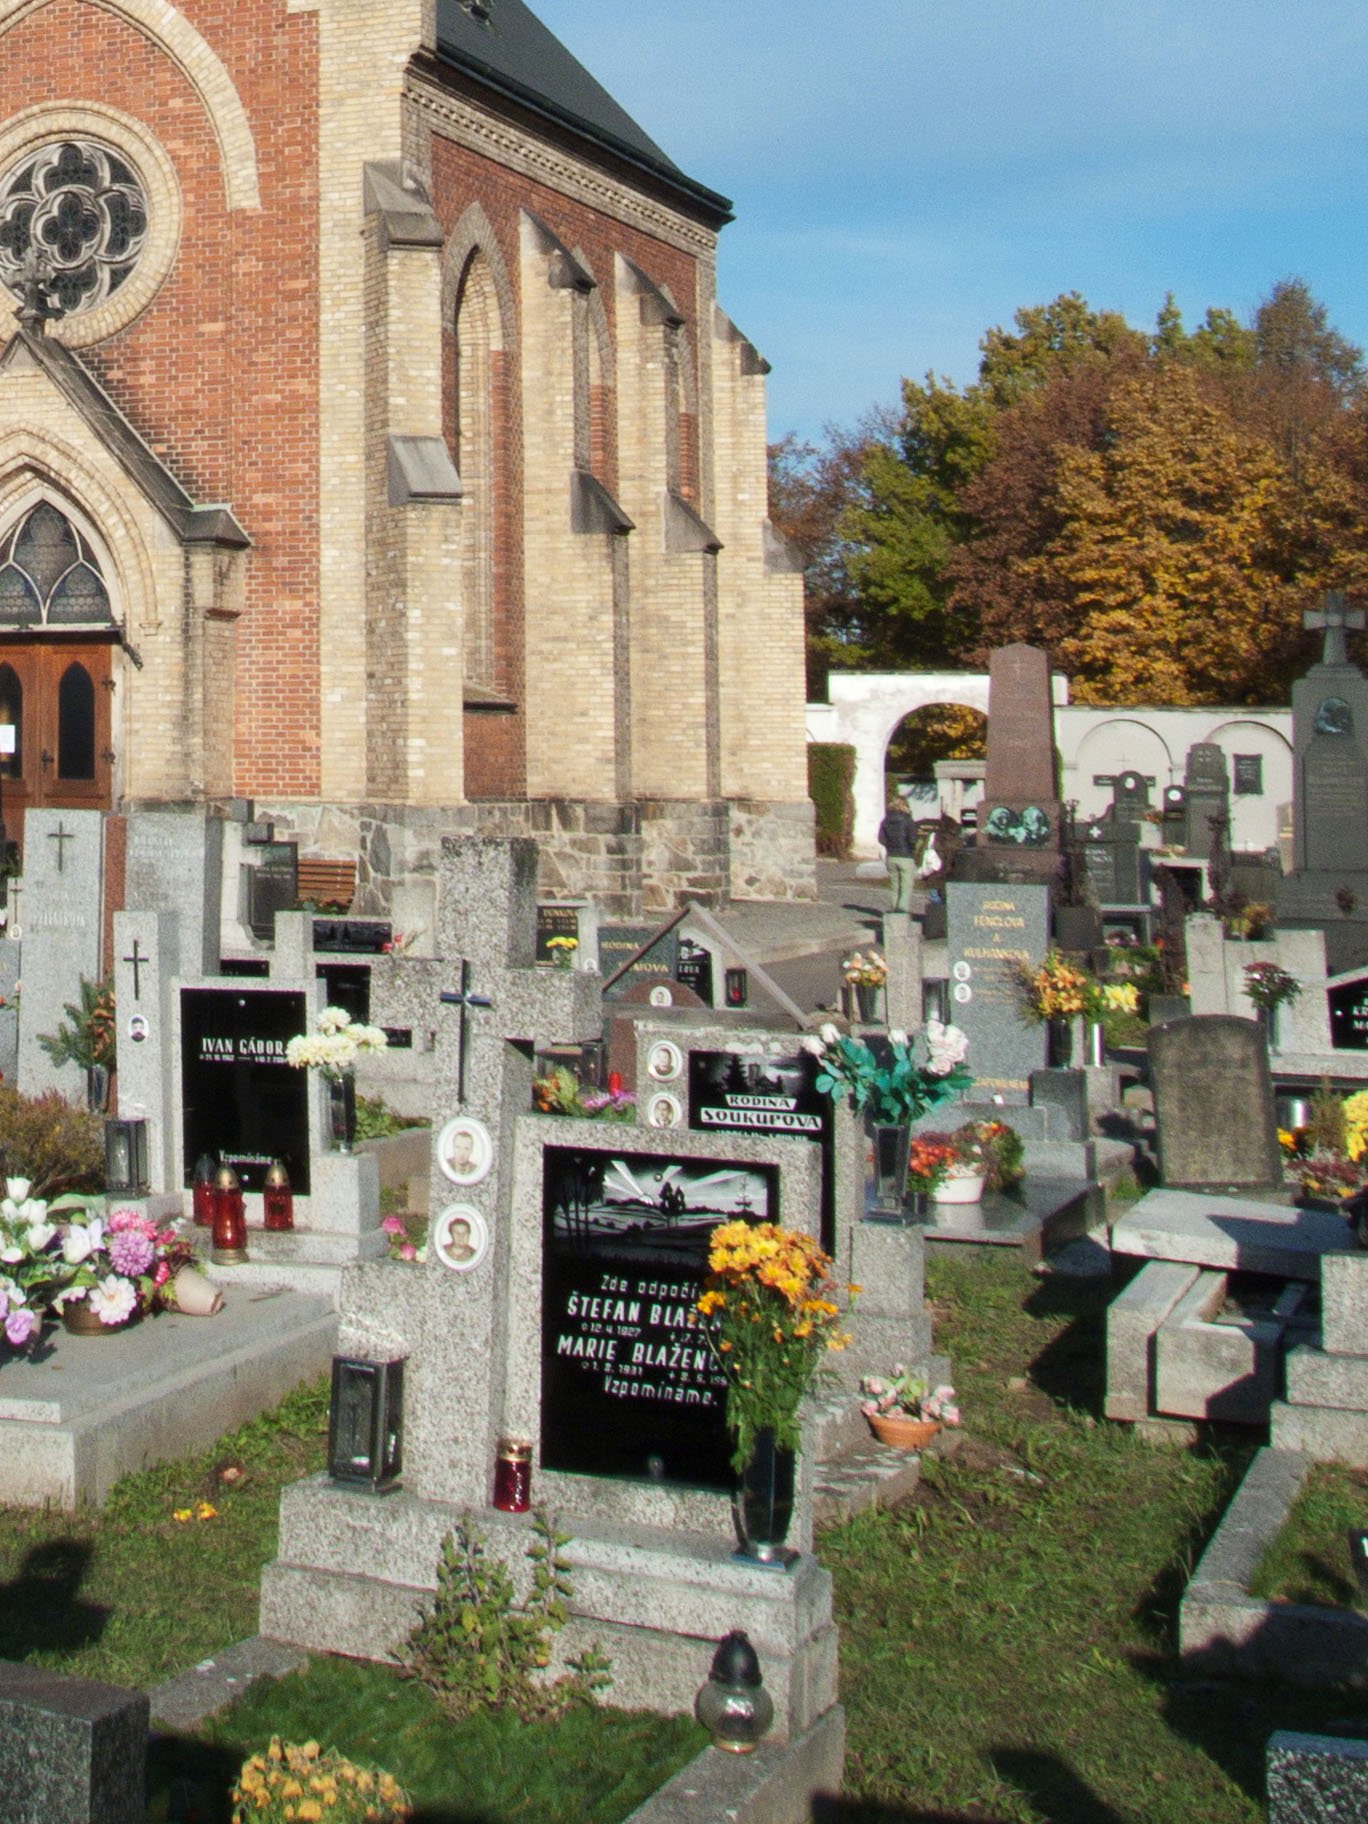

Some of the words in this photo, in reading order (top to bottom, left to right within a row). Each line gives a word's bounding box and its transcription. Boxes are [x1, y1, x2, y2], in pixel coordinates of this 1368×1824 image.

[202, 1038, 234, 1054] IVAN
[239, 1037, 285, 1055] GÁBOR
[729, 1095, 792, 1108] RODINA
[600, 1274, 629, 1293] Zde
[637, 1281, 699, 1300] odpočí
[567, 1290, 642, 1324] ŠTEFAN
[557, 1333, 618, 1362] MARIE
